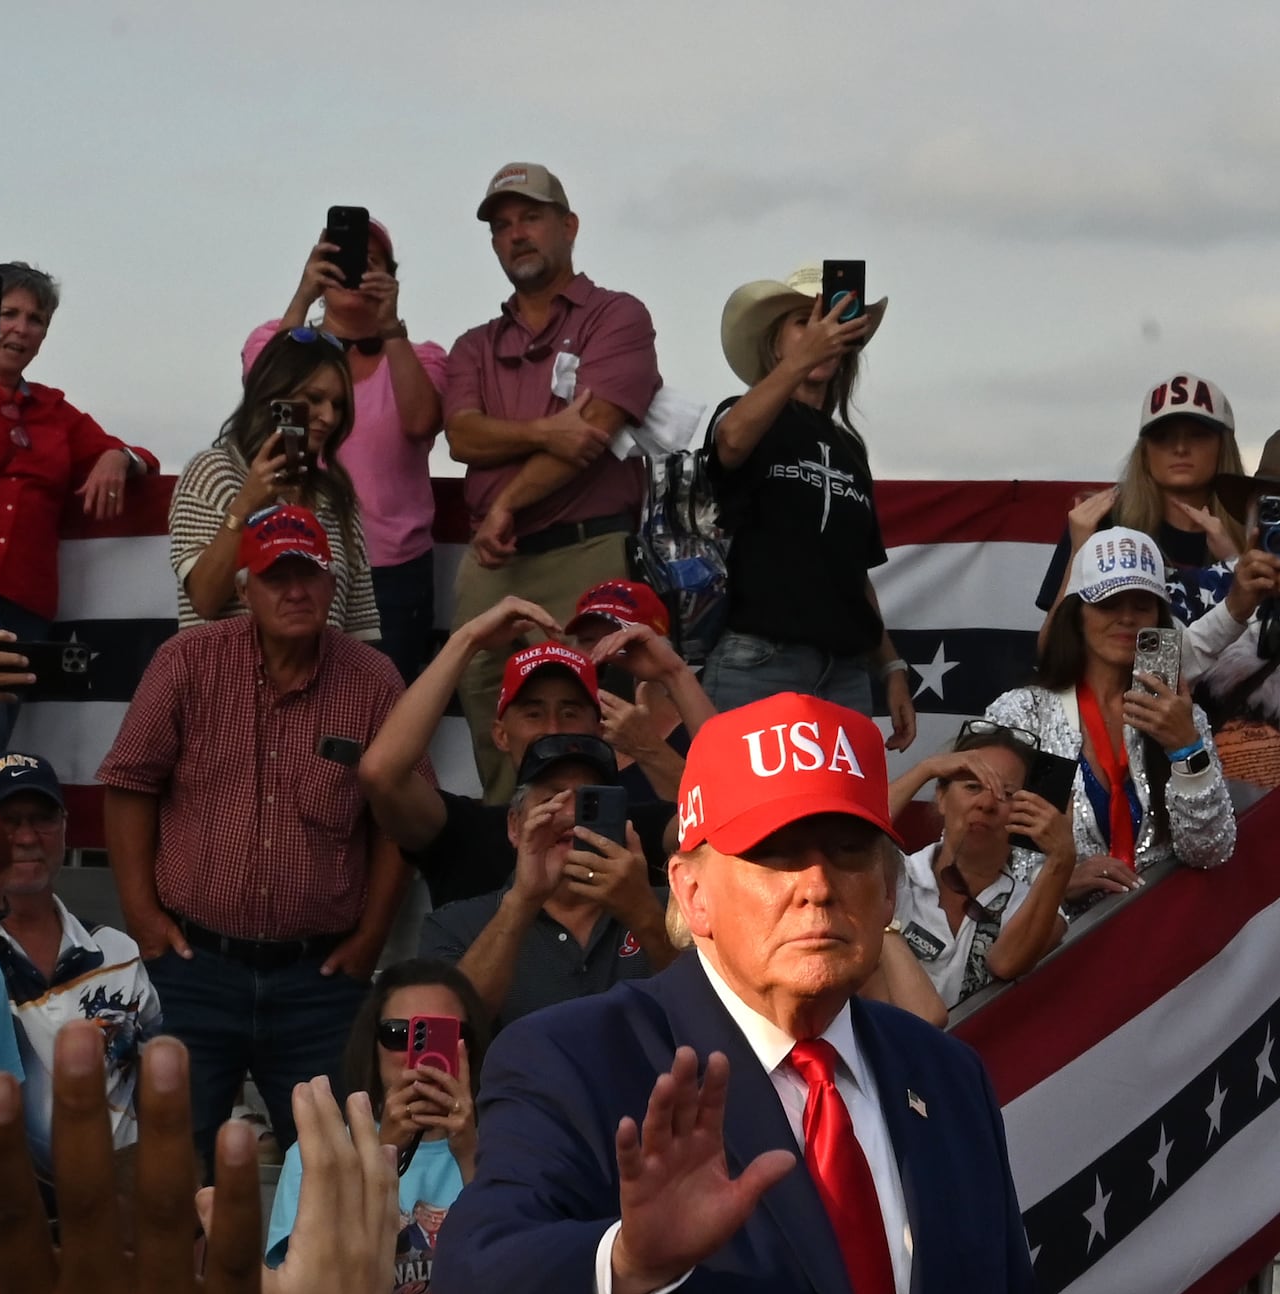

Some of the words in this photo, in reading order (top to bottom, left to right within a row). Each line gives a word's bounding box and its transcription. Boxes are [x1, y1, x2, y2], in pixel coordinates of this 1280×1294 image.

[1150, 376, 1214, 414] USA
[765, 464, 823, 489] JESUS
[1096, 538, 1156, 575] USA
[515, 647, 542, 665] MAKE
[545, 646, 586, 666] AMERICA
[520, 659, 551, 676] GRE
[742, 721, 865, 778] USA
[678, 785, 705, 844] -47
[904, 931, 939, 955] JACKSON
[394, 1260, 433, 1287] NAL
